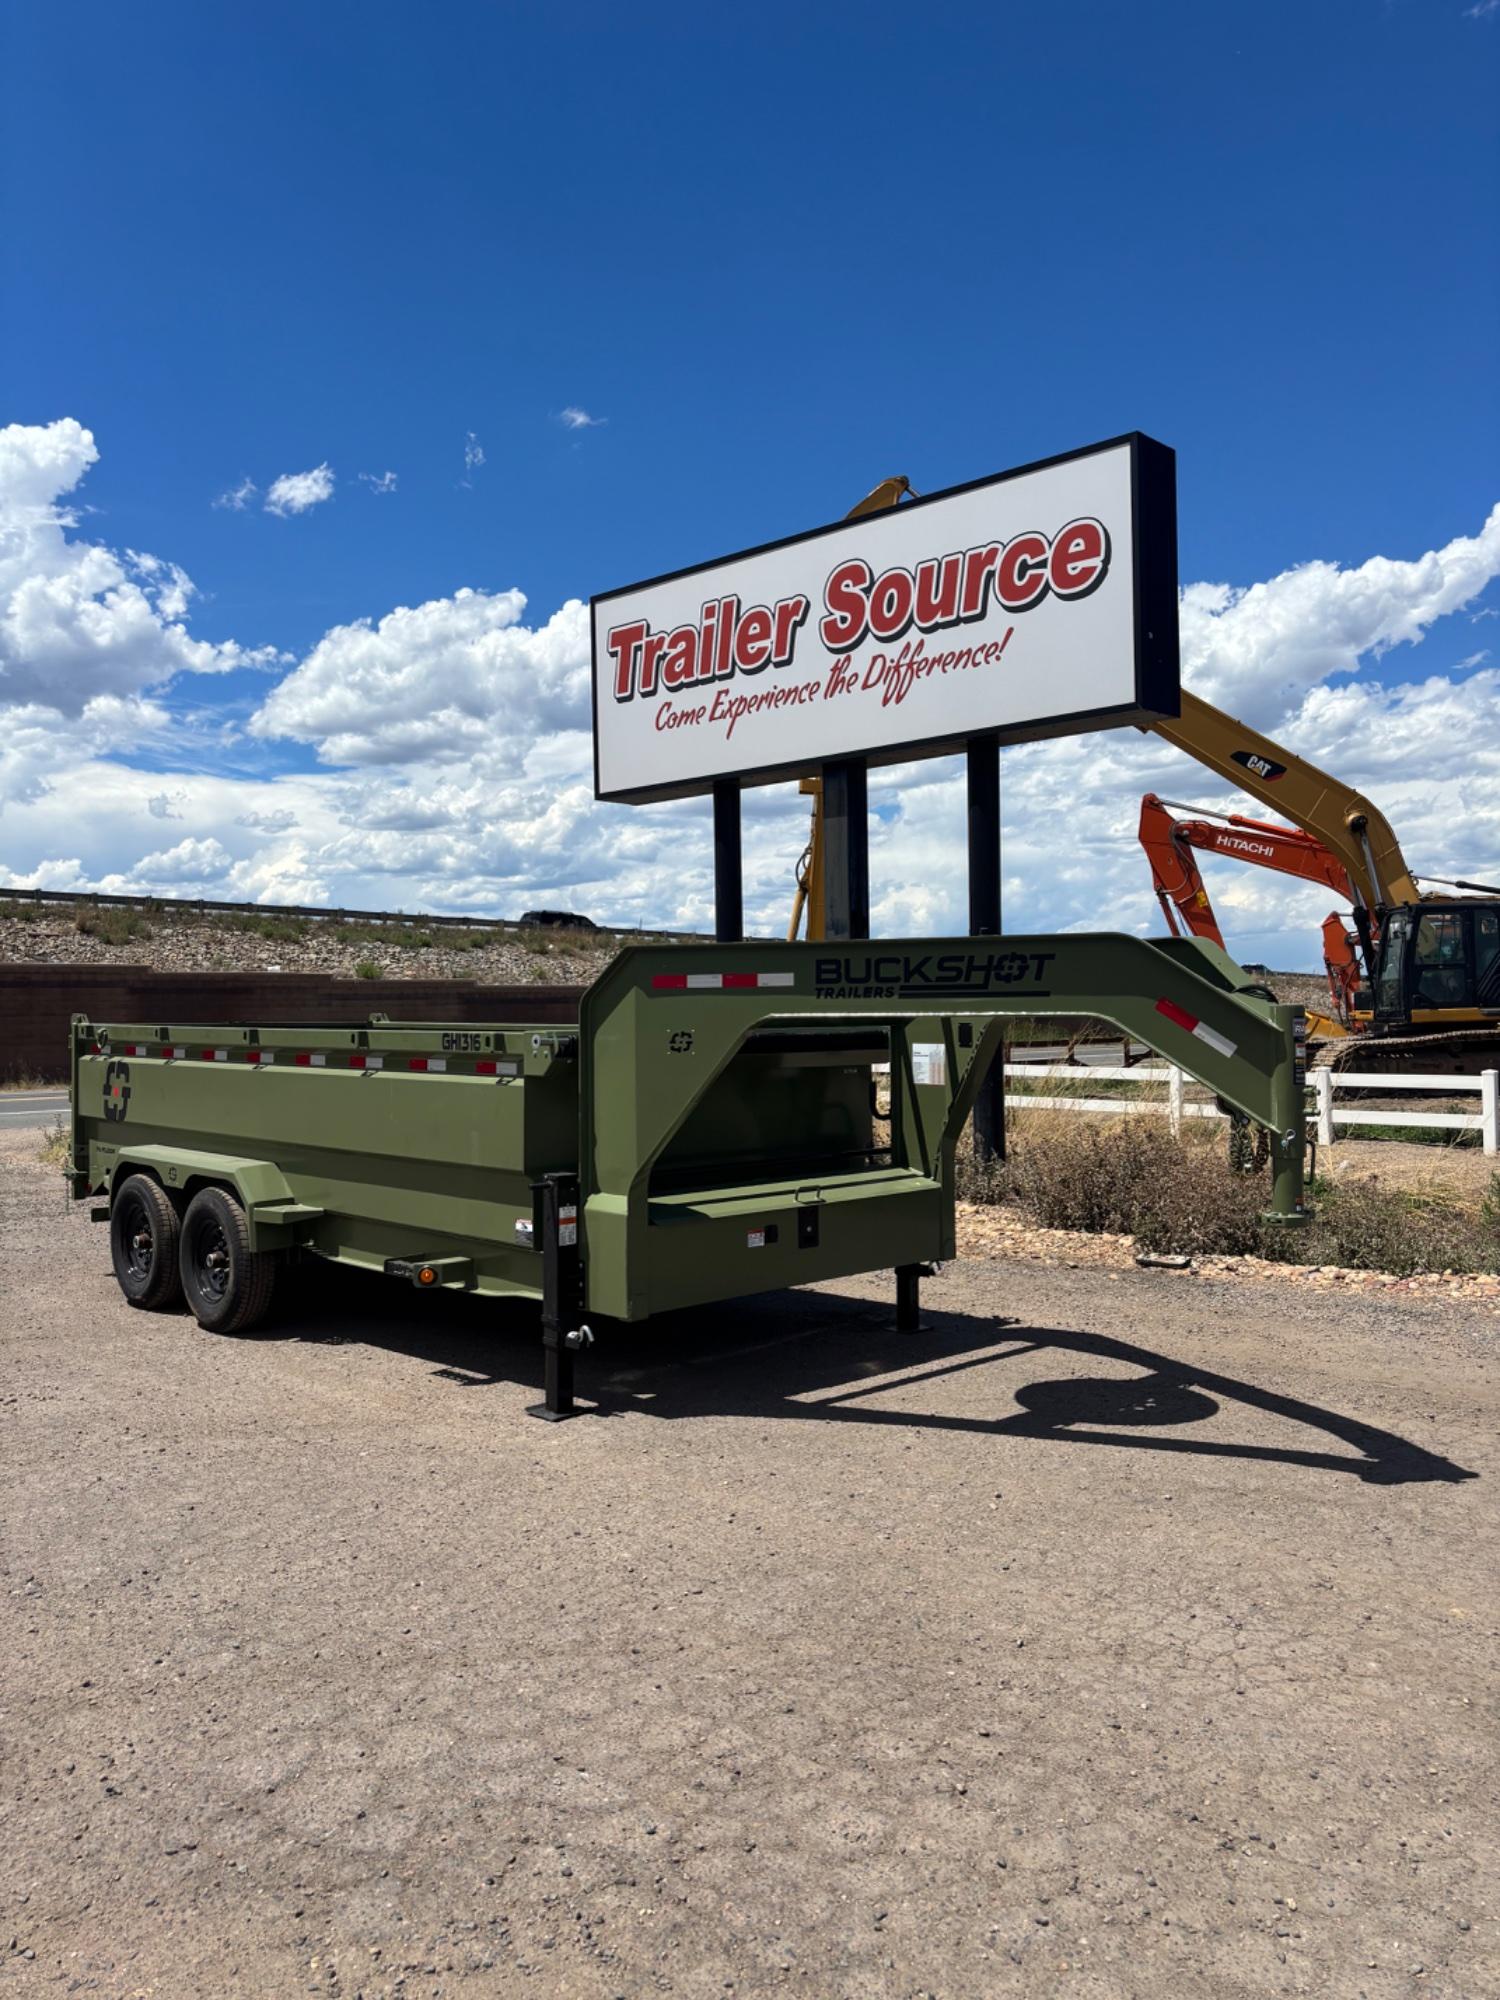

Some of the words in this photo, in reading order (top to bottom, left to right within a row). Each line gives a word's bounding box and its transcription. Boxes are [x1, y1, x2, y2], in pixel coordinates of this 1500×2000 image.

[608, 594, 810, 703] Trailer
[819, 517, 1112, 654] Source
[656, 701, 706, 731] Come
[709, 681, 820, 740] Experience
[824, 654, 858, 700] the
[861, 627, 1014, 707] Difference!
[1247, 755, 1272, 777] CAT
[1216, 835, 1274, 857] HITACHI
[815, 951, 1056, 989] BUCKSHOT
[815, 985, 895, 999] TRAILERS
